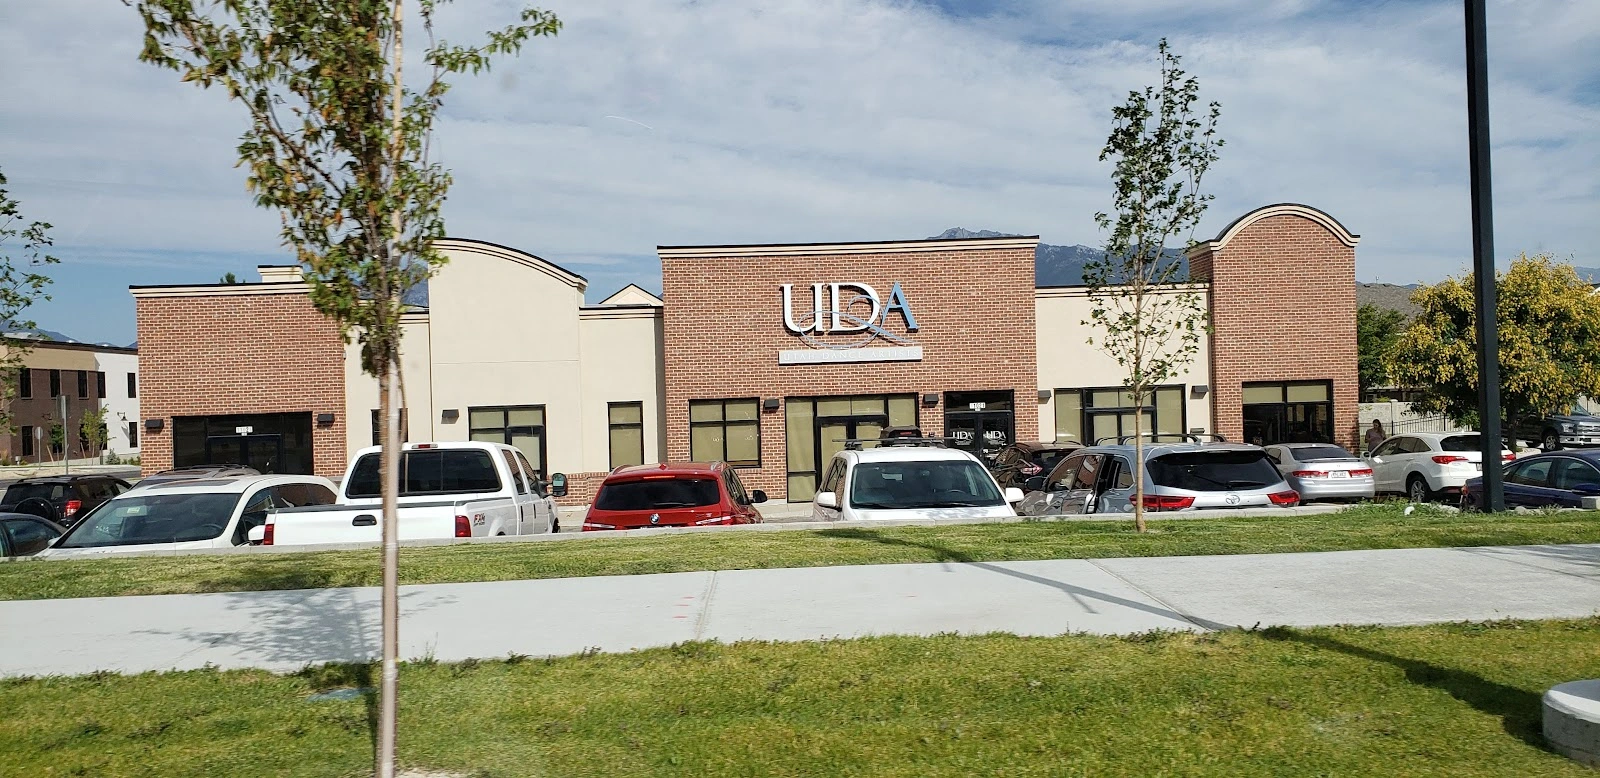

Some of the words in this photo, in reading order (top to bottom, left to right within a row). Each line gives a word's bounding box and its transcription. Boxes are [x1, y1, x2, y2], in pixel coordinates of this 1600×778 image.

[780, 281, 919, 333] UDA
[822, 351, 864, 360] DANCE
[871, 349, 919, 358] ARTISTS
[952, 430, 974, 440] UDA
